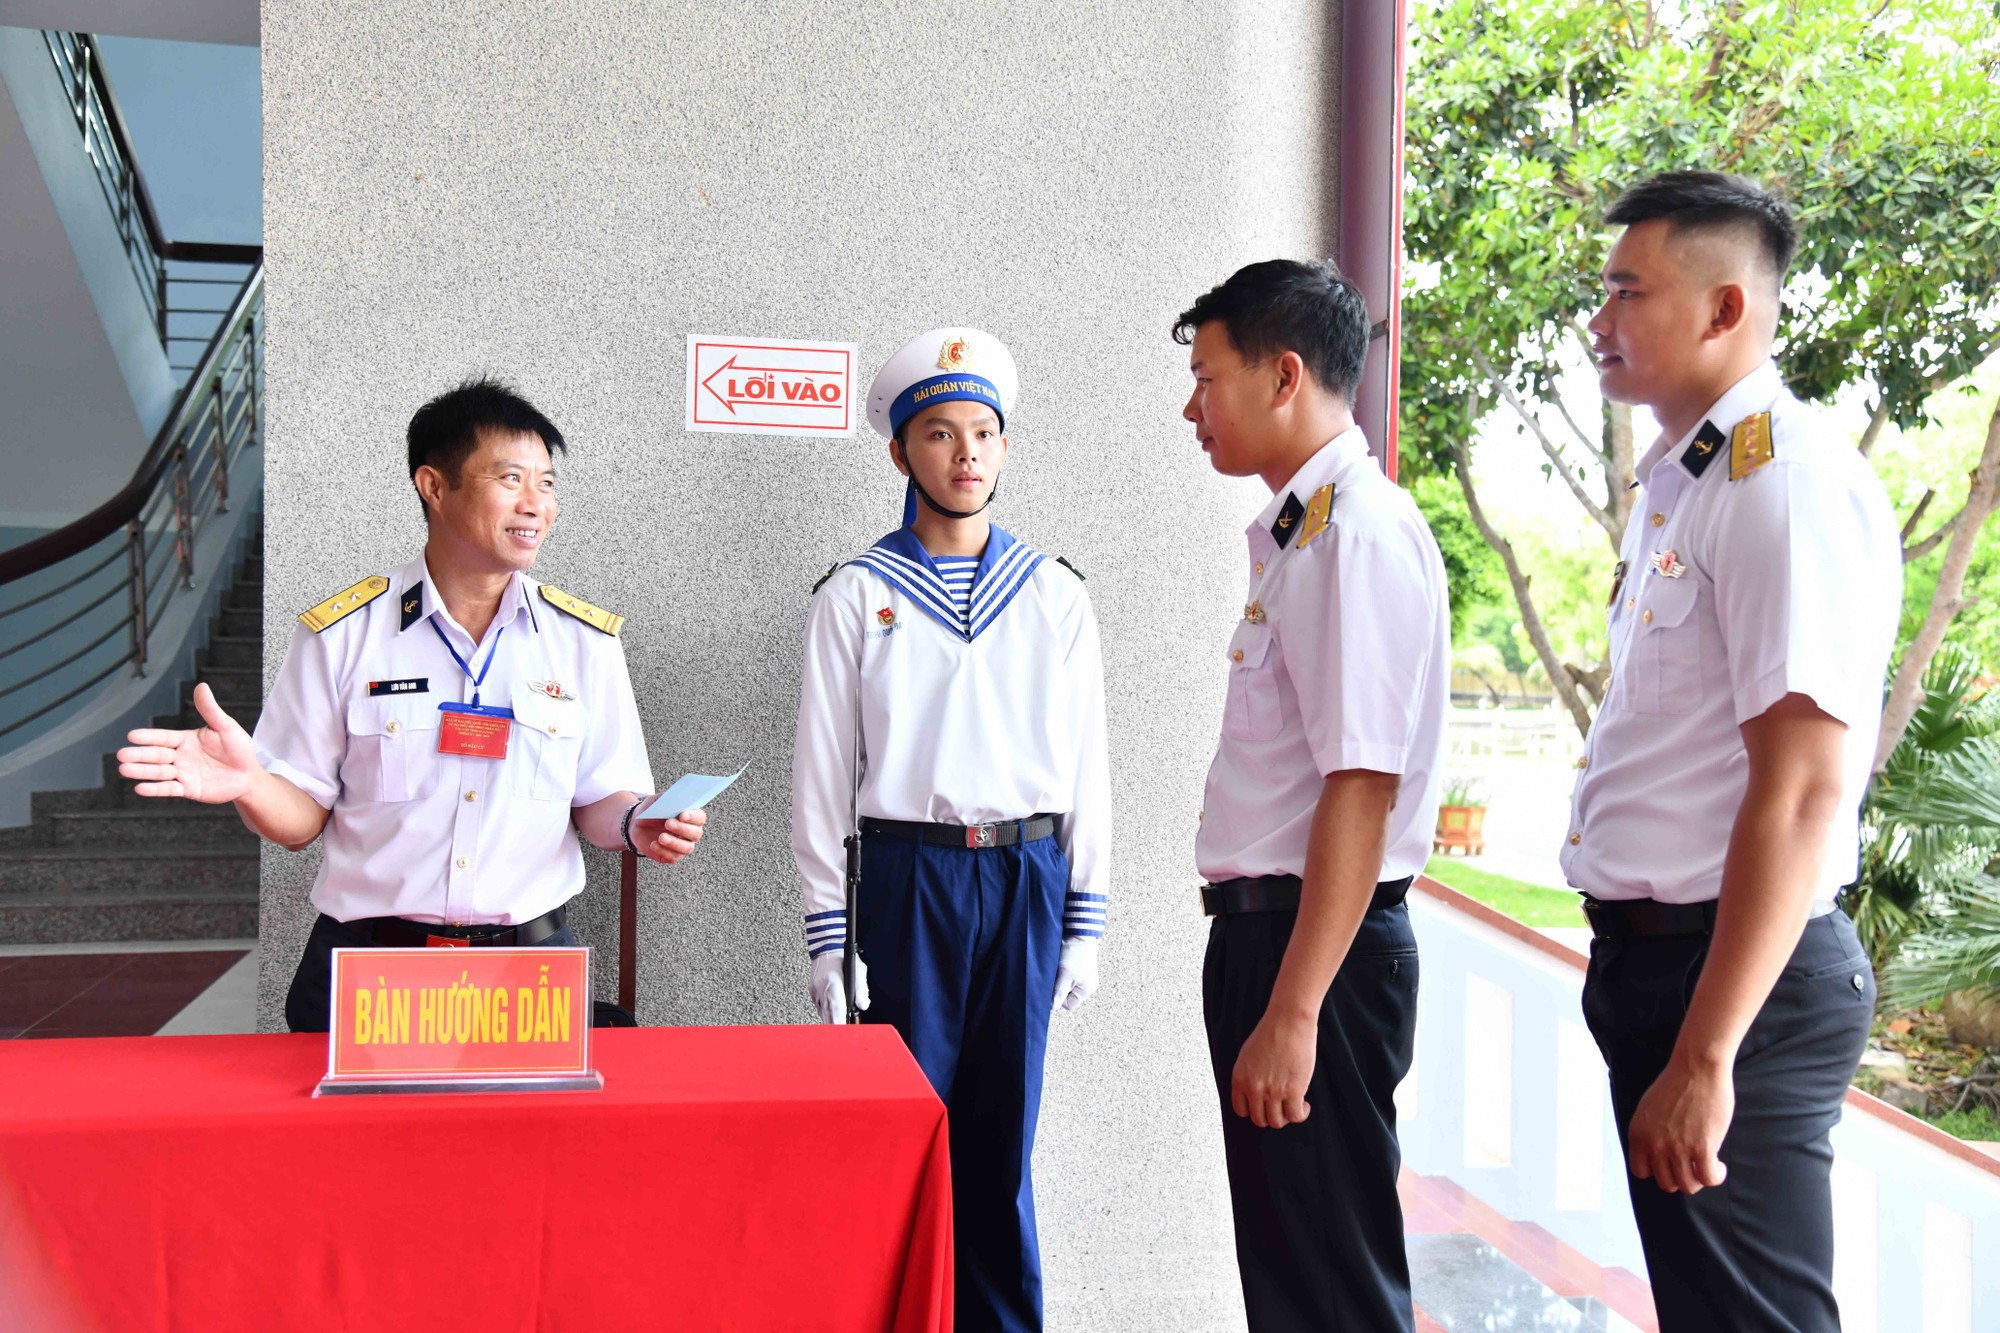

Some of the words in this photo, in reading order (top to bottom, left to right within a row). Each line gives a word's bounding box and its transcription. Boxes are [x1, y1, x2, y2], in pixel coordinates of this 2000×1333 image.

[781, 376, 841, 403] VÀO
[913, 386, 930, 403] HẢI
[930, 380, 958, 396] QUÂN
[958, 380, 982, 395] VIỆT
[982, 386, 998, 402] NAM
[354, 976, 411, 1045] BÀN
[418, 970, 509, 1044] HƯỚNG
[516, 964, 571, 1043] DẪN
